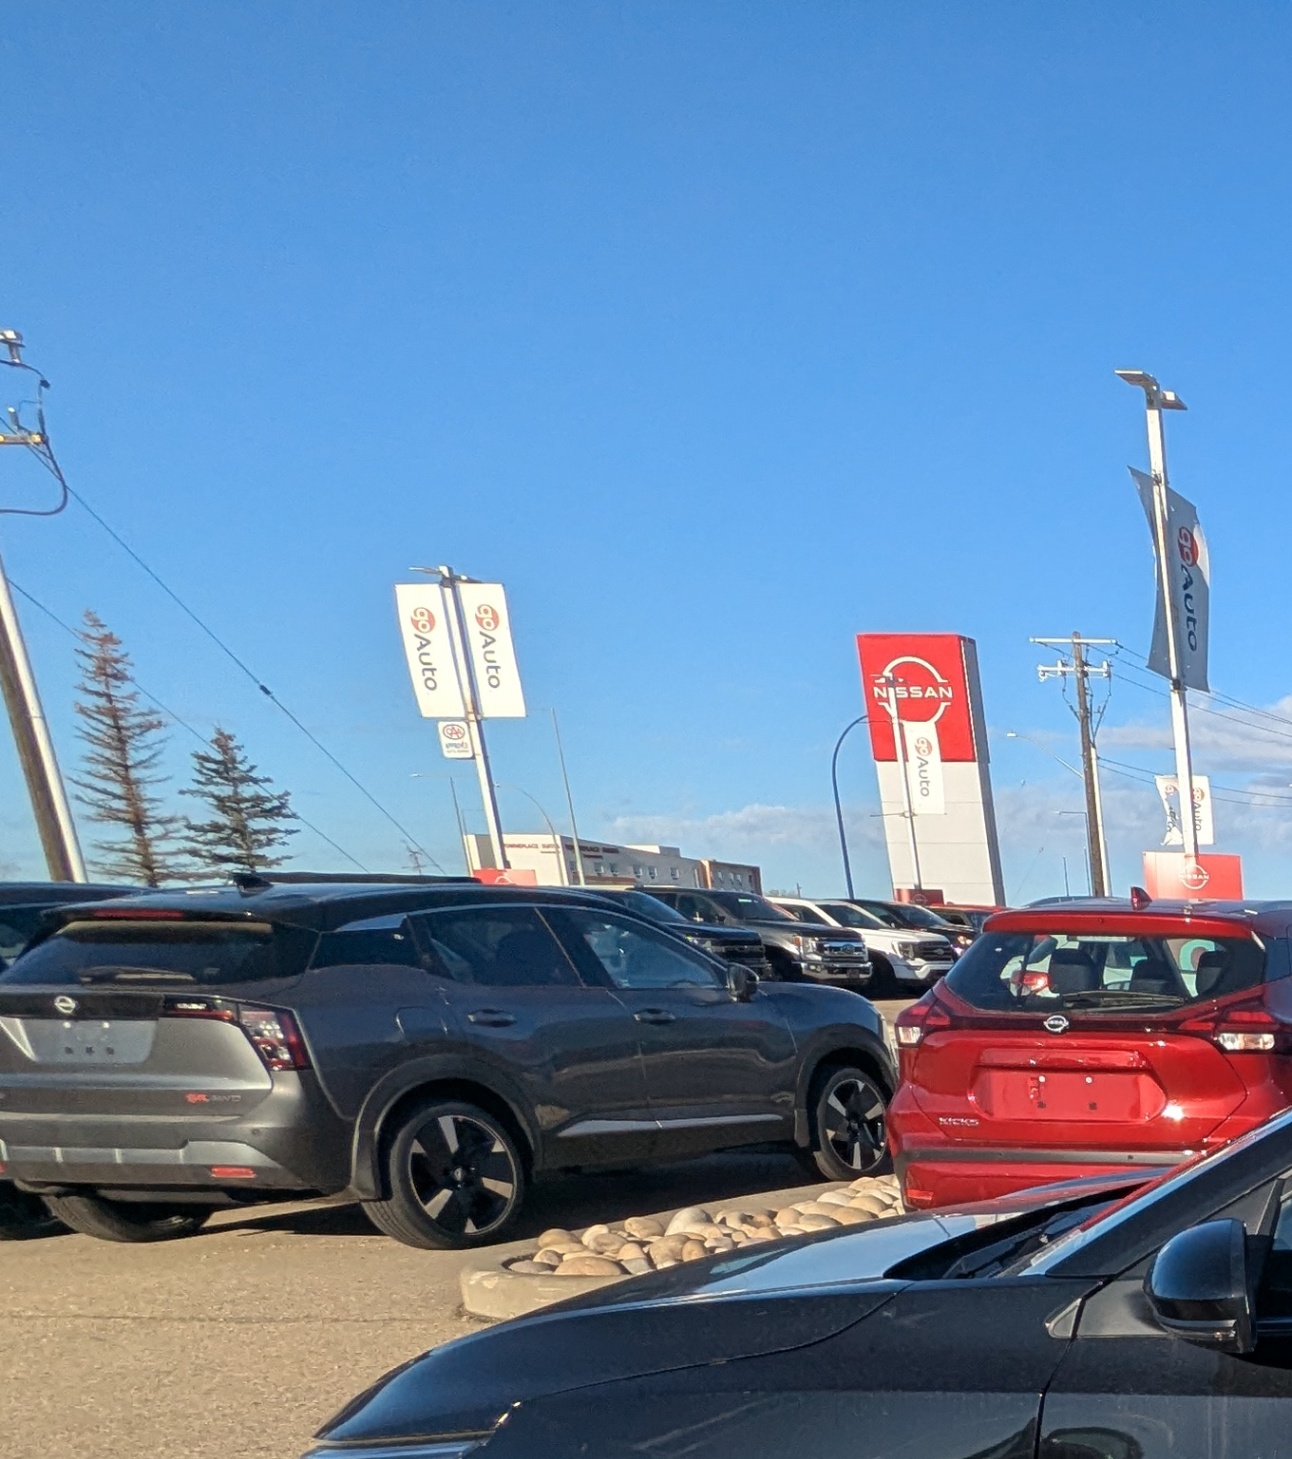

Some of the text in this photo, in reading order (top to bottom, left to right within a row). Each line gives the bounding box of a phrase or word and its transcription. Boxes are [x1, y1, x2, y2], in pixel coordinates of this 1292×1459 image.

[411, 607, 438, 691] go Auto
[475, 604, 501, 689] go Auto
[1181, 563, 1198, 652] Auto
[873, 686, 953, 698] NSSAN
[917, 756, 930, 797] Auto
